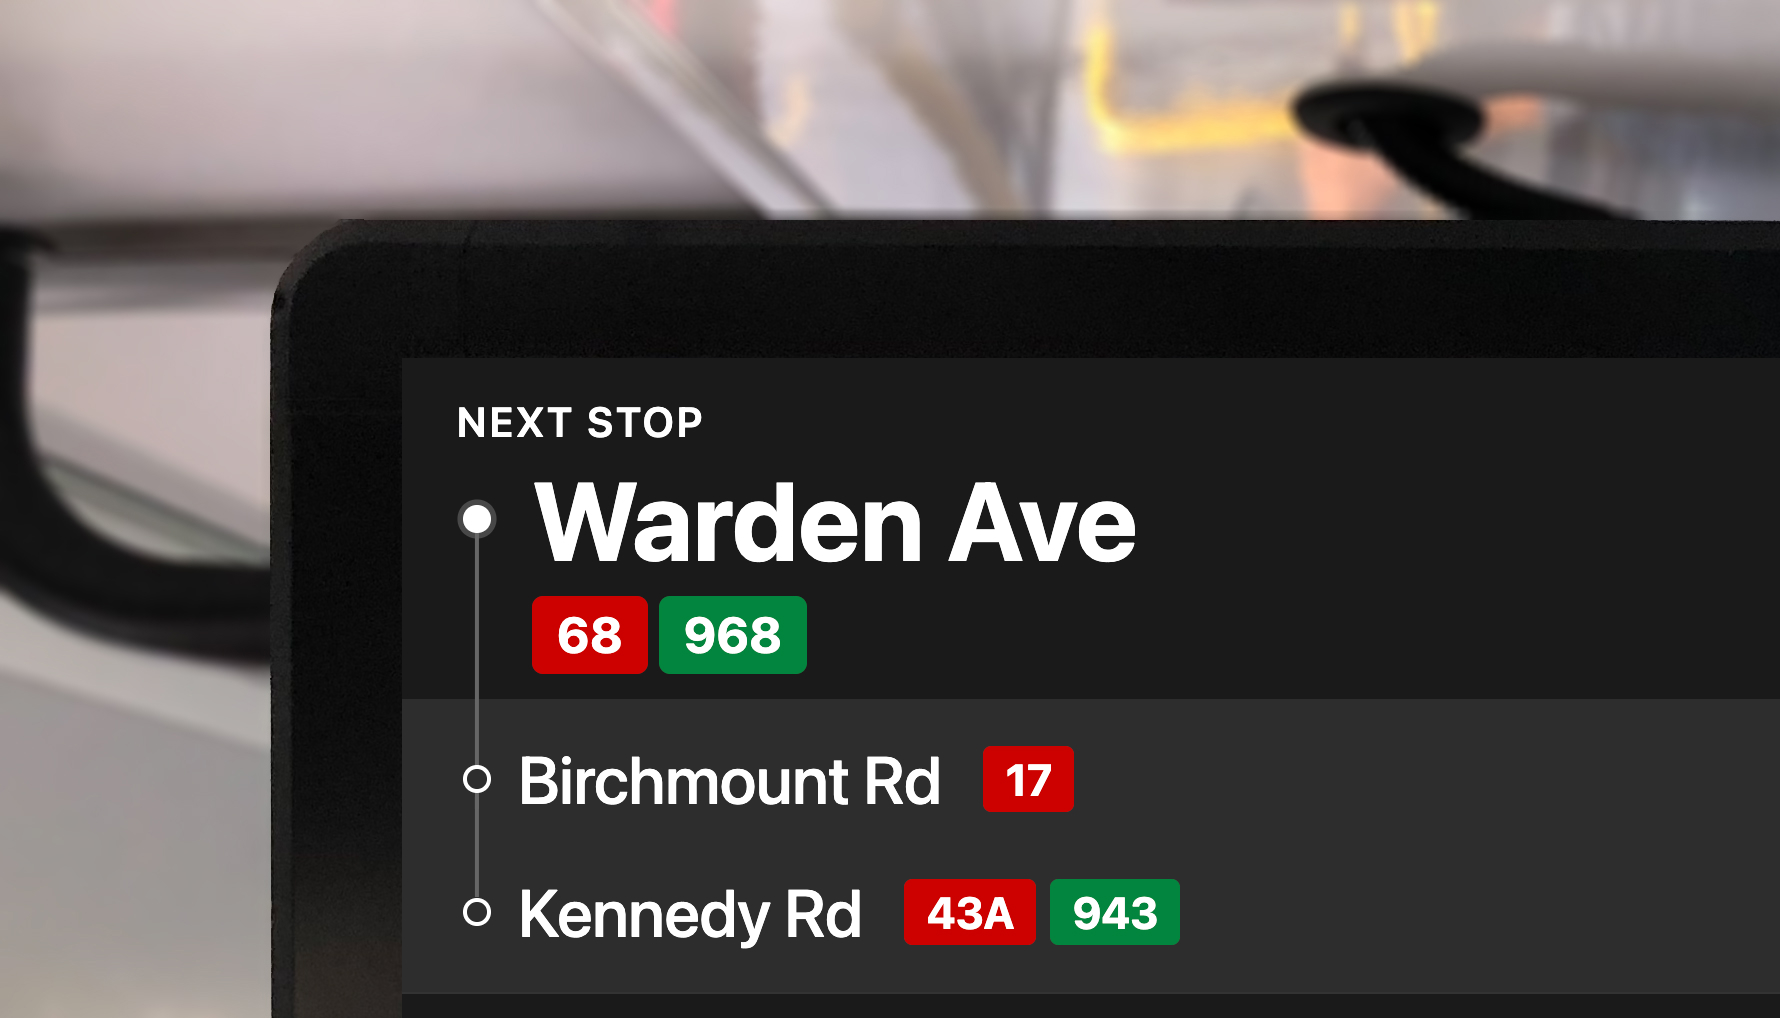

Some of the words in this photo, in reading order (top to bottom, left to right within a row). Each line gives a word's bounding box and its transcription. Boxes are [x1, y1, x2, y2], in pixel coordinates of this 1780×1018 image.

[459, 407, 572, 437] NEXT
[588, 406, 702, 438] STOP
[534, 482, 920, 562] Warden
[948, 482, 1135, 562] Ave
[559, 617, 621, 654] 68
[685, 616, 780, 654] 968
[522, 756, 848, 805] Birchmount
[867, 756, 939, 805] Rd
[1007, 764, 1051, 796] 17
[522, 889, 771, 949] Kennedy
[788, 889, 860, 938] Rd
[928, 896, 1014, 930] 43A
[1074, 896, 1157, 930] 943
